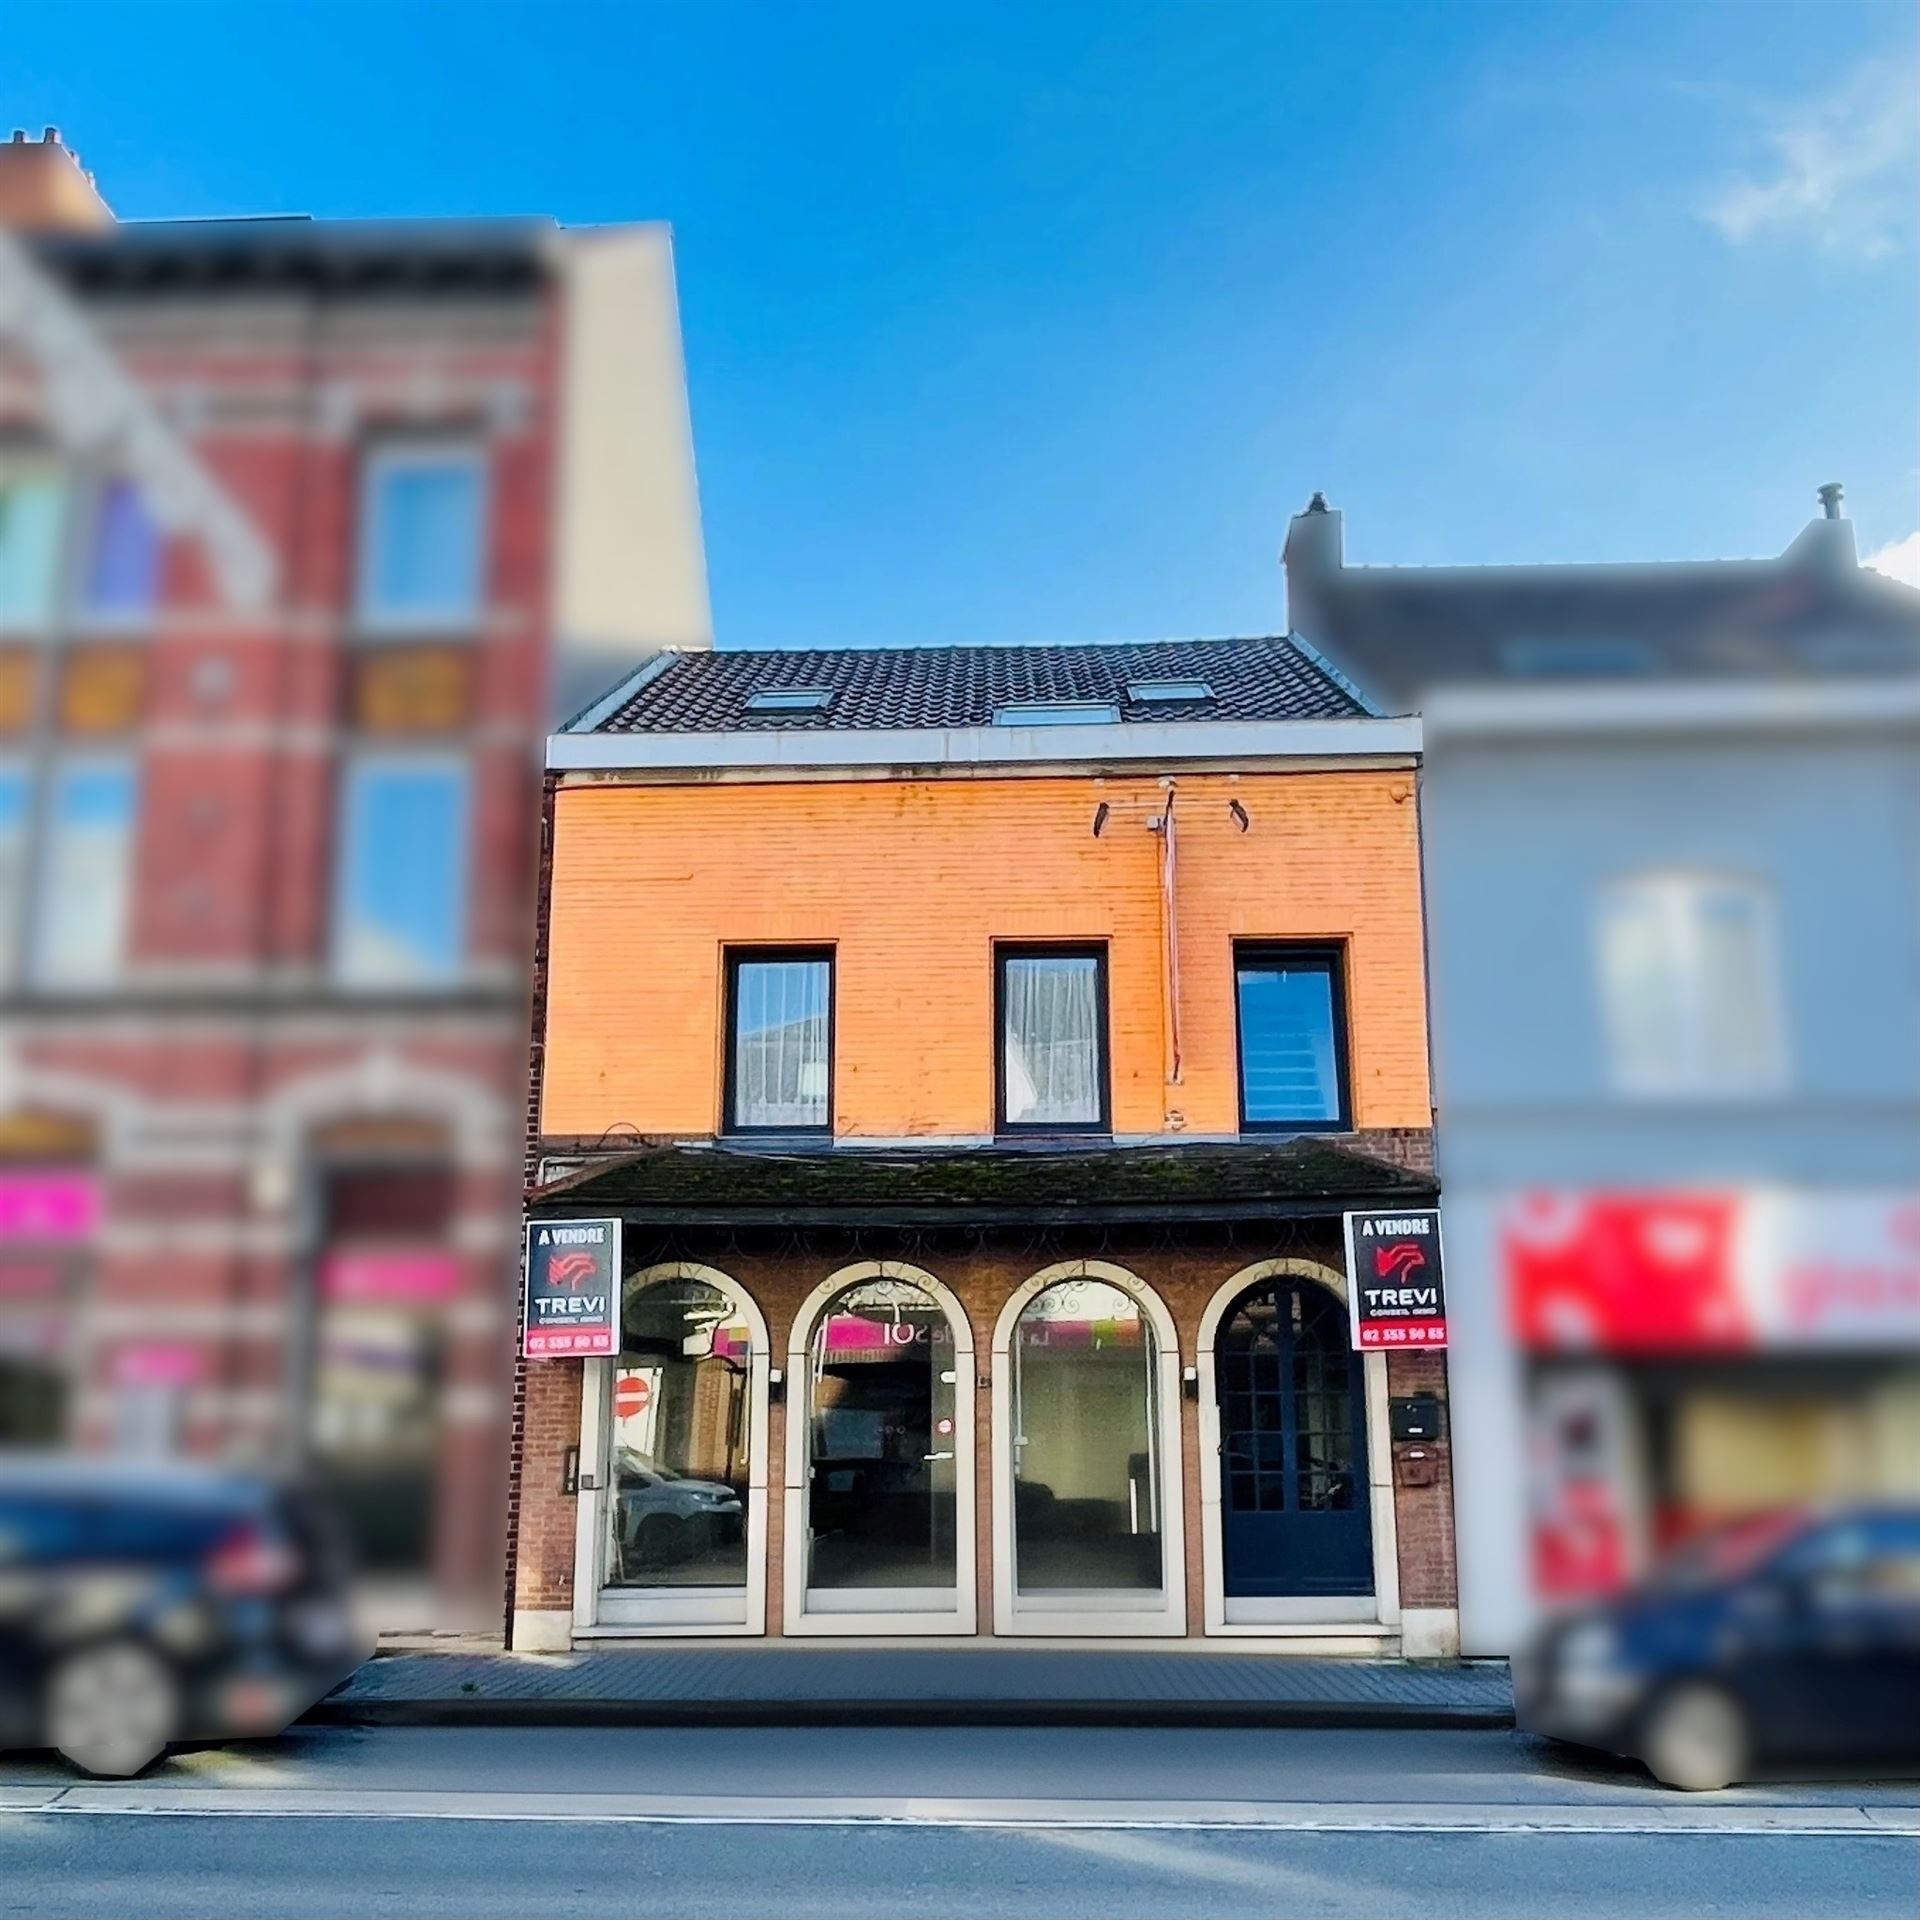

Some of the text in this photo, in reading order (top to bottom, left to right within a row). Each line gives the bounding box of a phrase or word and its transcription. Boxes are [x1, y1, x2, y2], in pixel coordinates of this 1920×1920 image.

[1362, 1218, 1430, 1236] A VENDRE
[538, 1227, 605, 1246] A VENDRE
[535, 1296, 606, 1314] TREVI
[1364, 1287, 1437, 1306] TREVI
[1362, 1329, 1380, 1342] 02
